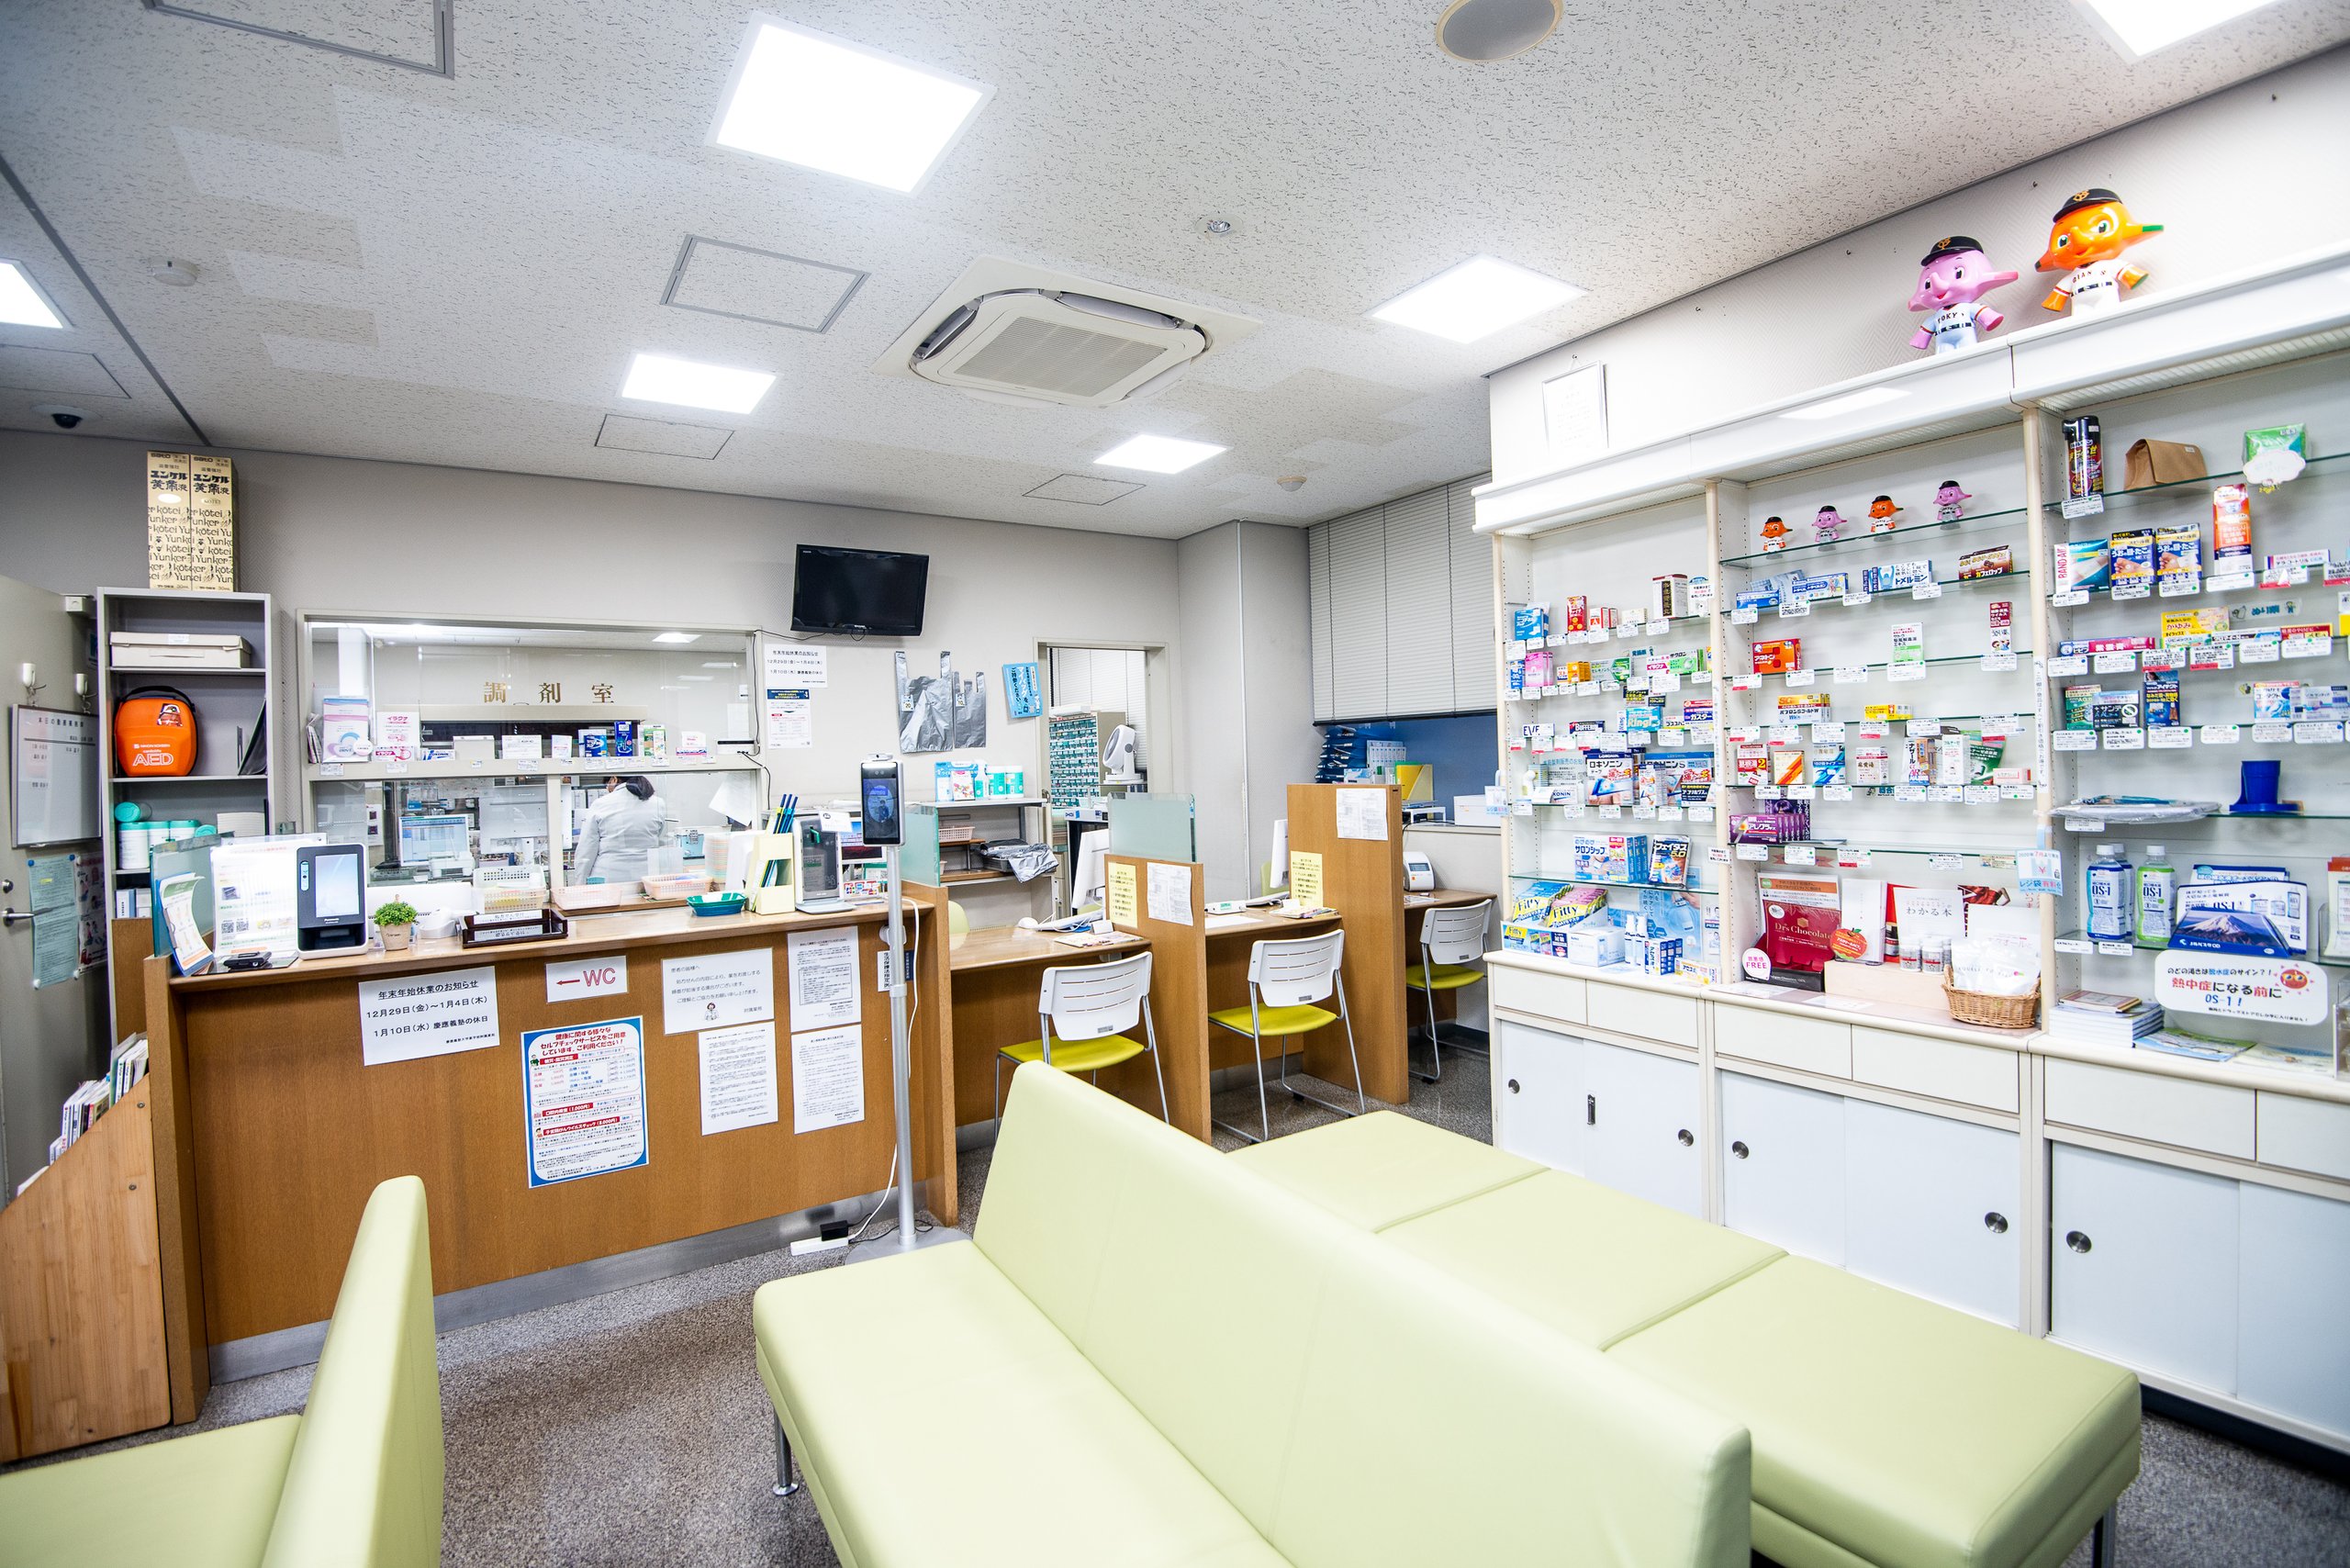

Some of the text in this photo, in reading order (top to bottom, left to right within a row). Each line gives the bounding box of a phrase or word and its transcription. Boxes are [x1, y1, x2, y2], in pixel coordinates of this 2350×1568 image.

[2072, 269, 2107, 284] GIANS
[151, 470, 188, 480] ユンケル
[193, 474, 230, 484] ユンケル
[1975, 567, 2003, 578] カフェロップ
[1895, 575, 1928, 585] トメルミン
[483, 681, 614, 704] 調剤室
[1690, 713, 1713, 722] ガスター
[132, 752, 174, 767] AED
[1589, 760, 1623, 768] ロキソニン
[1574, 846, 1606, 855] サロンシップ
[1653, 843, 1687, 851] フェイタス
[2092, 885, 2110, 896] OS-1
[2143, 886, 2162, 898] OS-1
[1553, 905, 1579, 919] Fitty
[1906, 906, 1953, 917] わかる本
[1508, 925, 1522, 935] Fitty
[1746, 961, 1767, 969] FREE
[583, 967, 617, 988] WC
[2167, 968, 2272, 976] のどの渇きは脱水症のサイン？！
[378, 980, 479, 1000] 年末年始休業のお知らせ
[2172, 977, 2282, 999] 熱中症になる前に
